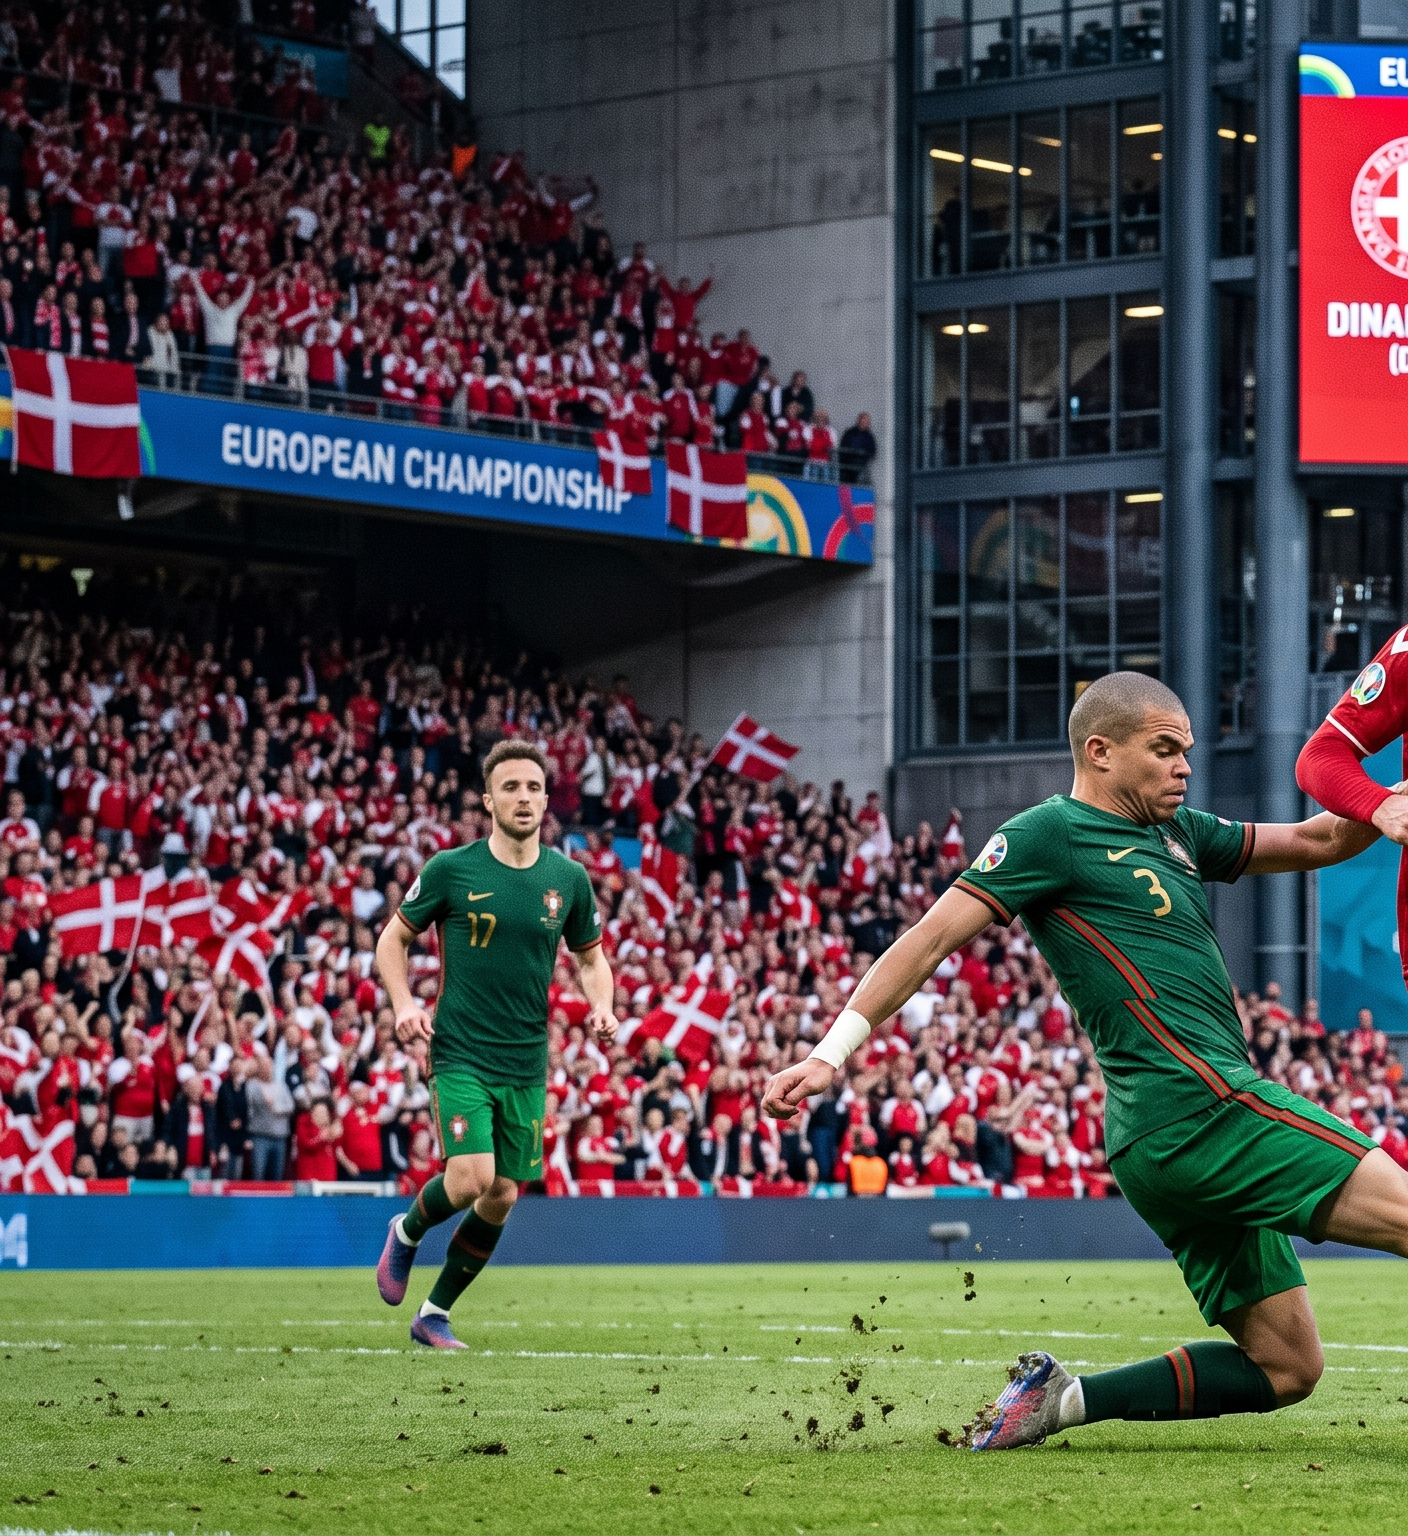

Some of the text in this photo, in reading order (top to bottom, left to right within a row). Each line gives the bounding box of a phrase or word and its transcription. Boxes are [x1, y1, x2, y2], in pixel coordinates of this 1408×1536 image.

[221, 422, 396, 486] EUROPEAN
[1133, 868, 1172, 917] 3
[467, 911, 497, 948] 17
